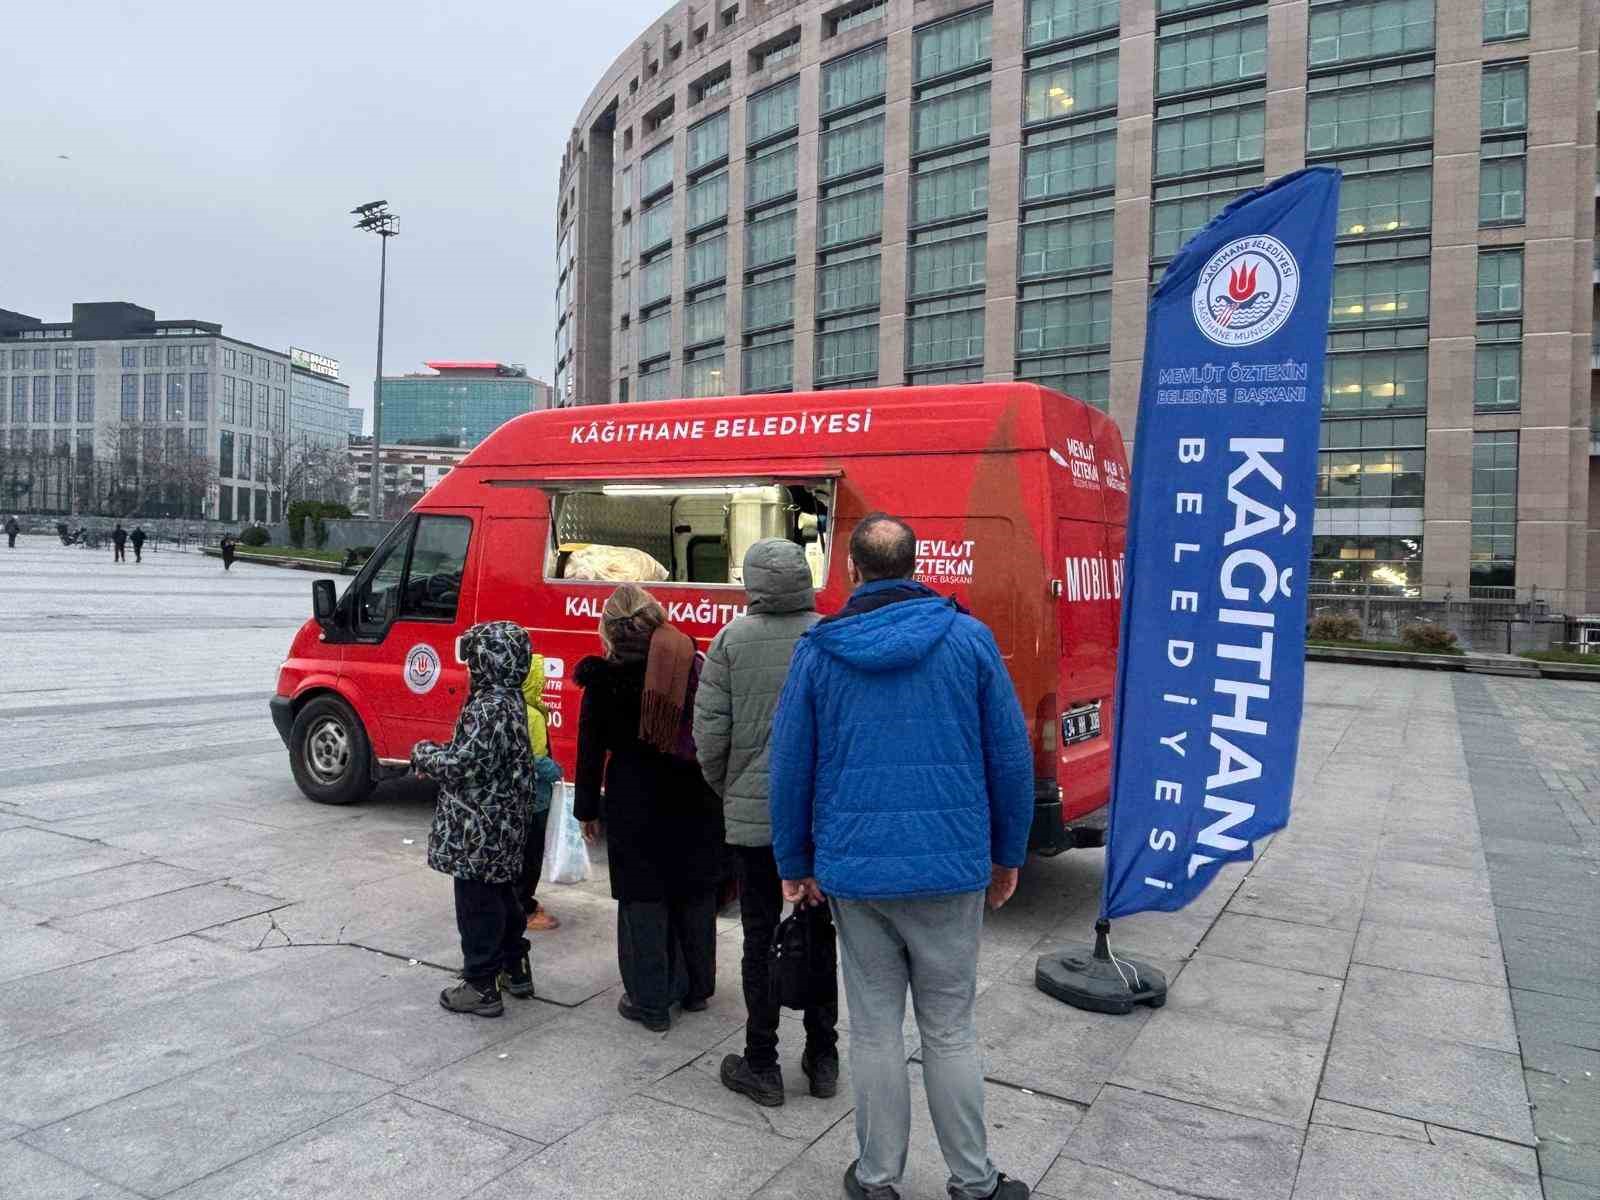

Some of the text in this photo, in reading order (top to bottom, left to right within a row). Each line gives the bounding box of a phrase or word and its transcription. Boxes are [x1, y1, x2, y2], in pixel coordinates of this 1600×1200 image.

[1157, 386, 1307, 406] BELEDİYE BAŞKANI
[570, 408, 873, 444] KÂĞITHANE BELEDİYESİ
[1065, 551, 1112, 602] MOBİL
[668, 598, 748, 625] KAĞITH
[1144, 437, 1206, 890] BELEDİYESİ
